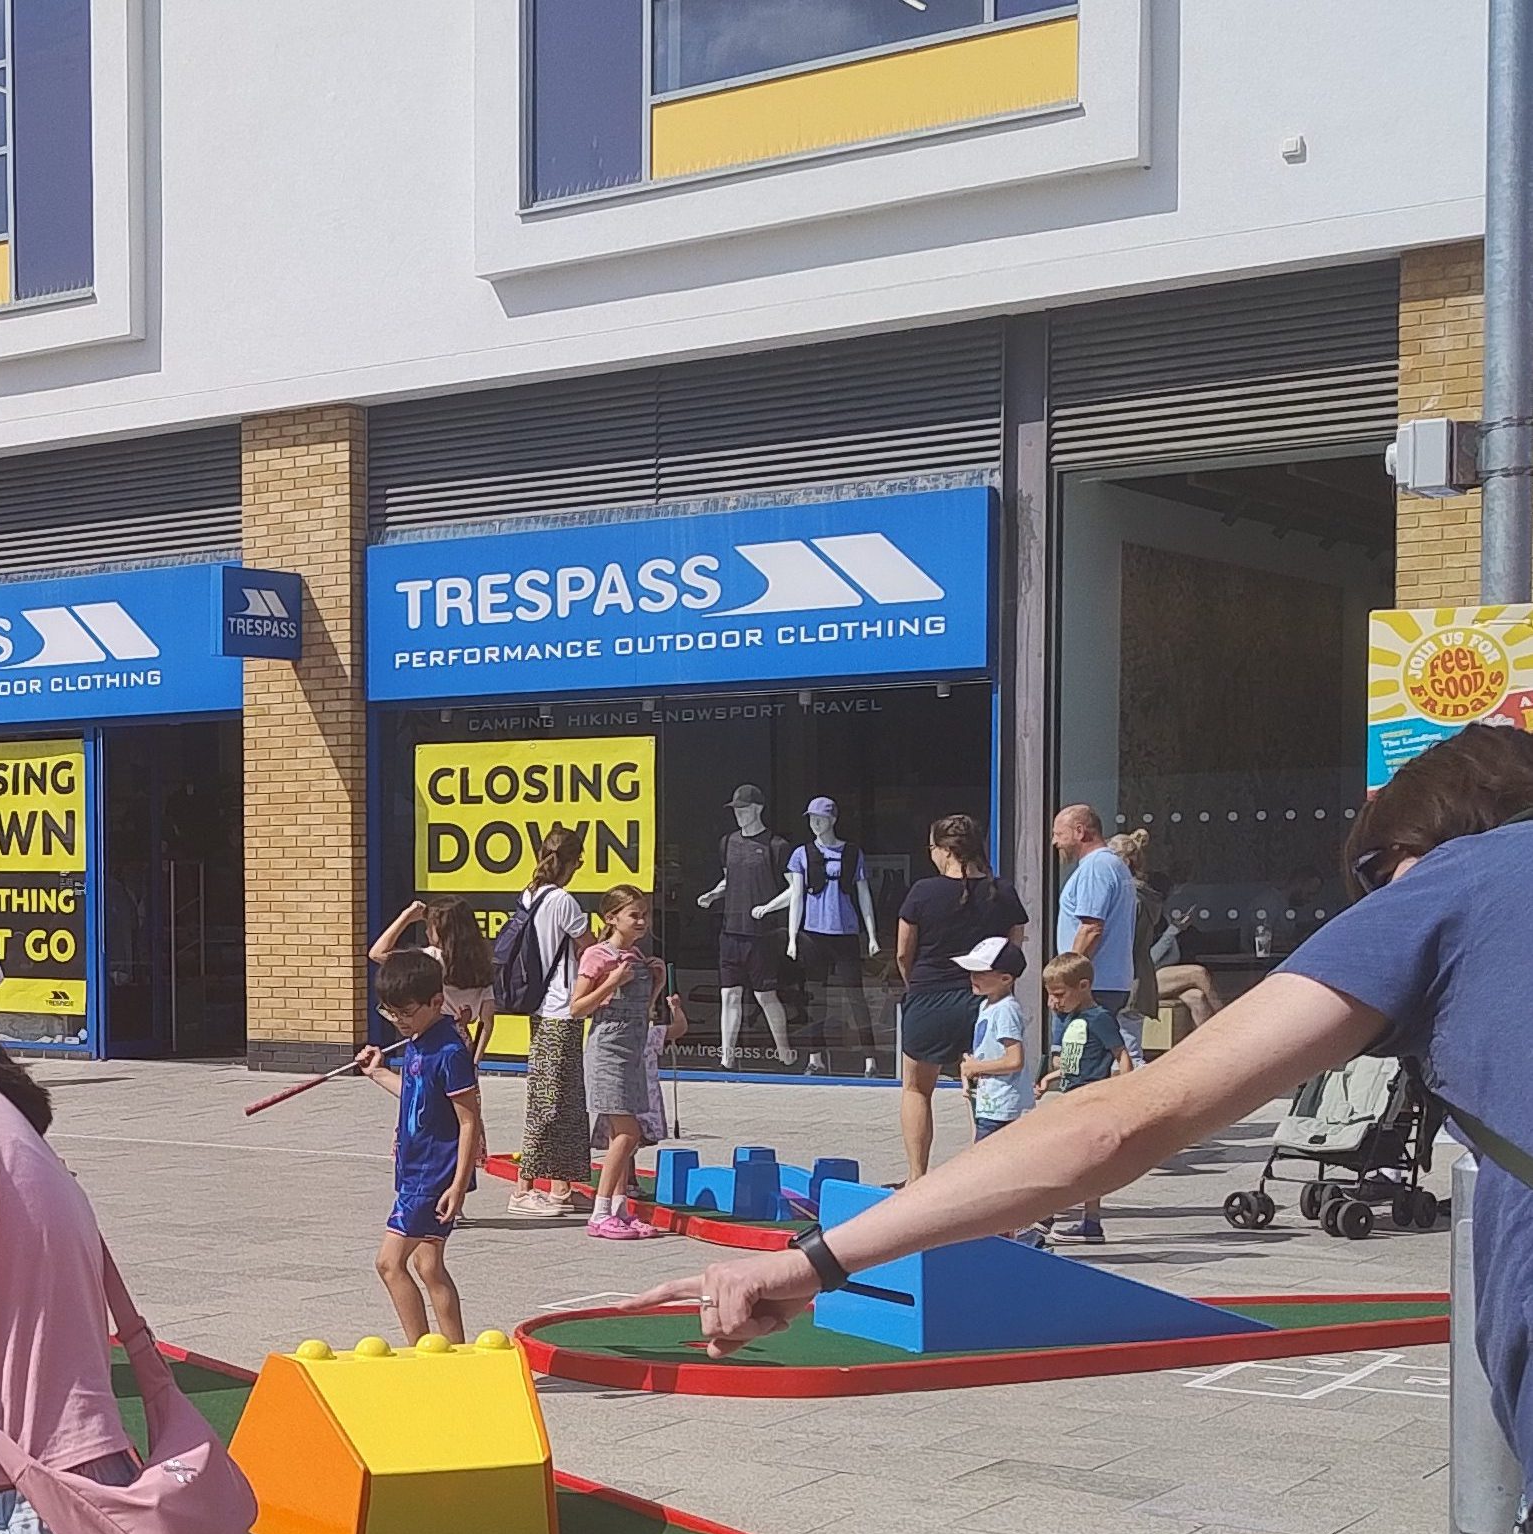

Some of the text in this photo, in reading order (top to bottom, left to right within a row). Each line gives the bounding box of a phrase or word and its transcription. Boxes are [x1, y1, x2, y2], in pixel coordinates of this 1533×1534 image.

[395, 554, 721, 629] TRESPASS
[227, 617, 297, 638] TRESPASS
[394, 616, 946, 669] PERFORMANCE OUTDOOR CLOTHING
[1409, 641, 1438, 679] JOIN
[1439, 631, 1465, 646] US
[50, 669, 162, 693] CLOTHING
[1431, 671, 1485, 699] GOOD
[468, 699, 883, 732] CAMPING HIKING SNOWSPORT TRAVEL
[428, 762, 640, 806] CLOSING
[24, 929, 76, 963] GO
